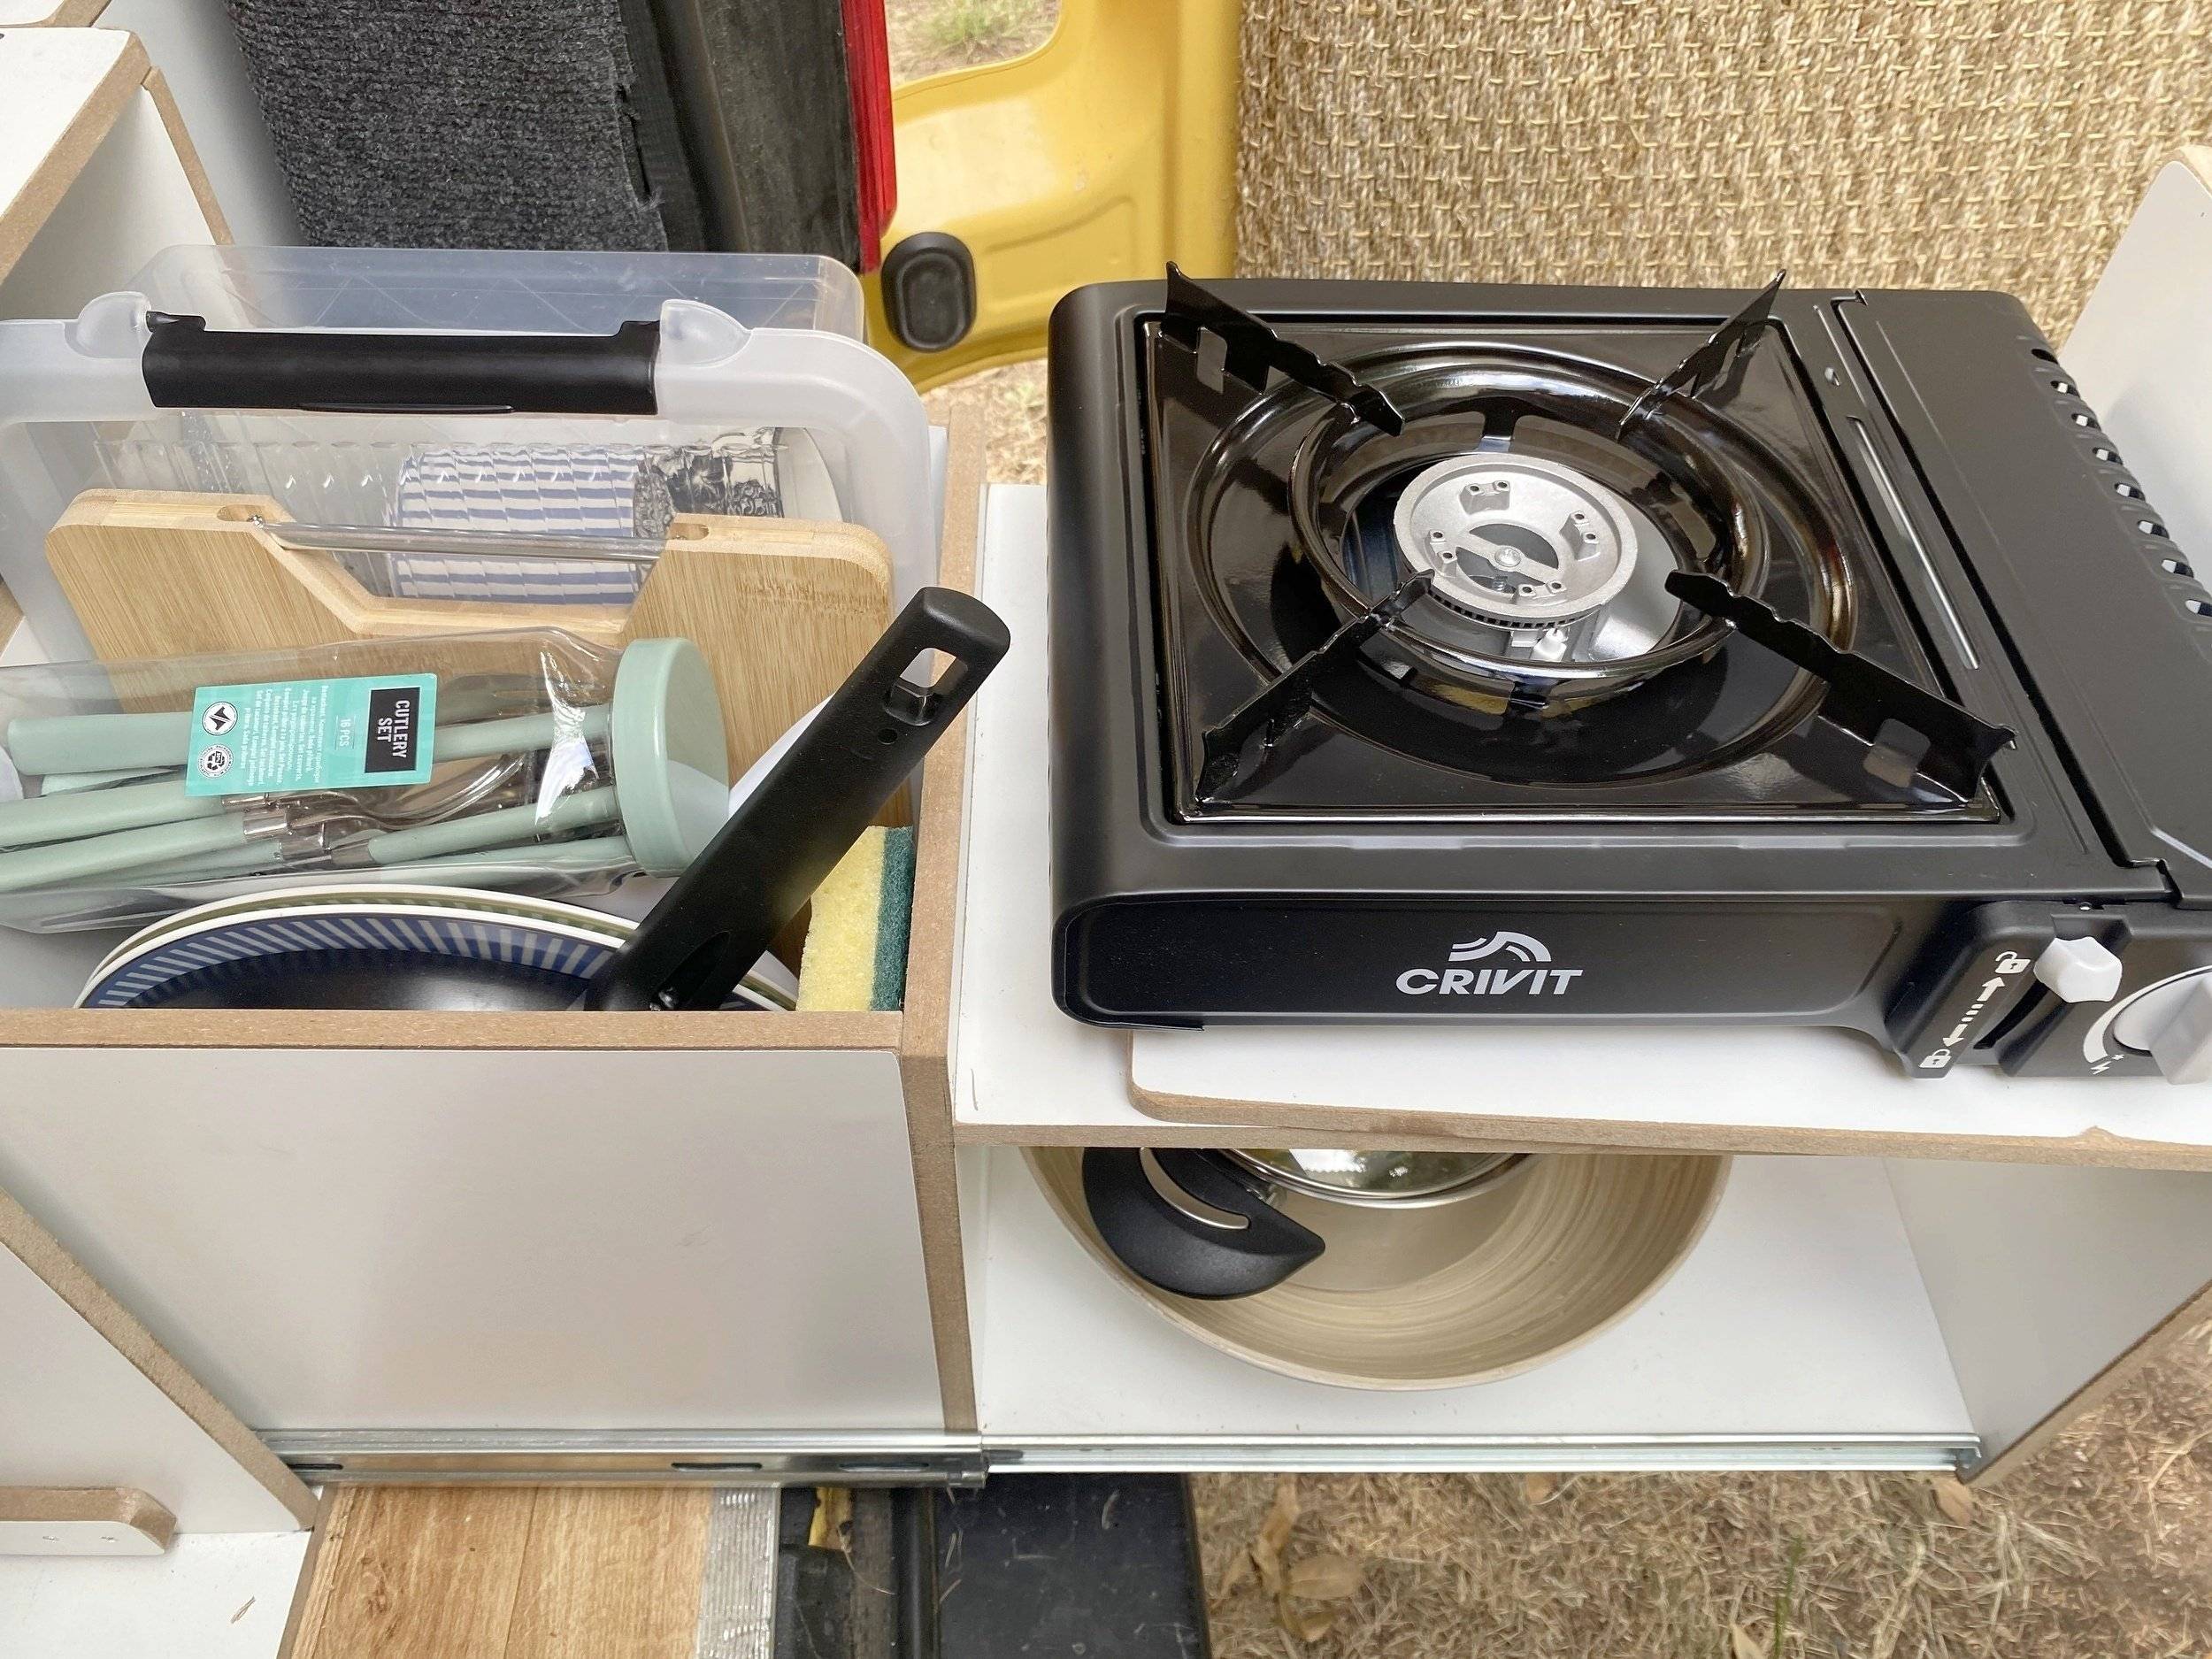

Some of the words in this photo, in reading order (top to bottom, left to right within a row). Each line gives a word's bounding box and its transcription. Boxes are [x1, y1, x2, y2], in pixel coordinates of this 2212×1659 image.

[340, 718, 351, 728] 16
[377, 718, 393, 742] SET
[392, 700, 411, 758] CUTLERY
[339, 729, 350, 747] PCS
[1395, 968, 1584, 995] CRIVIT
